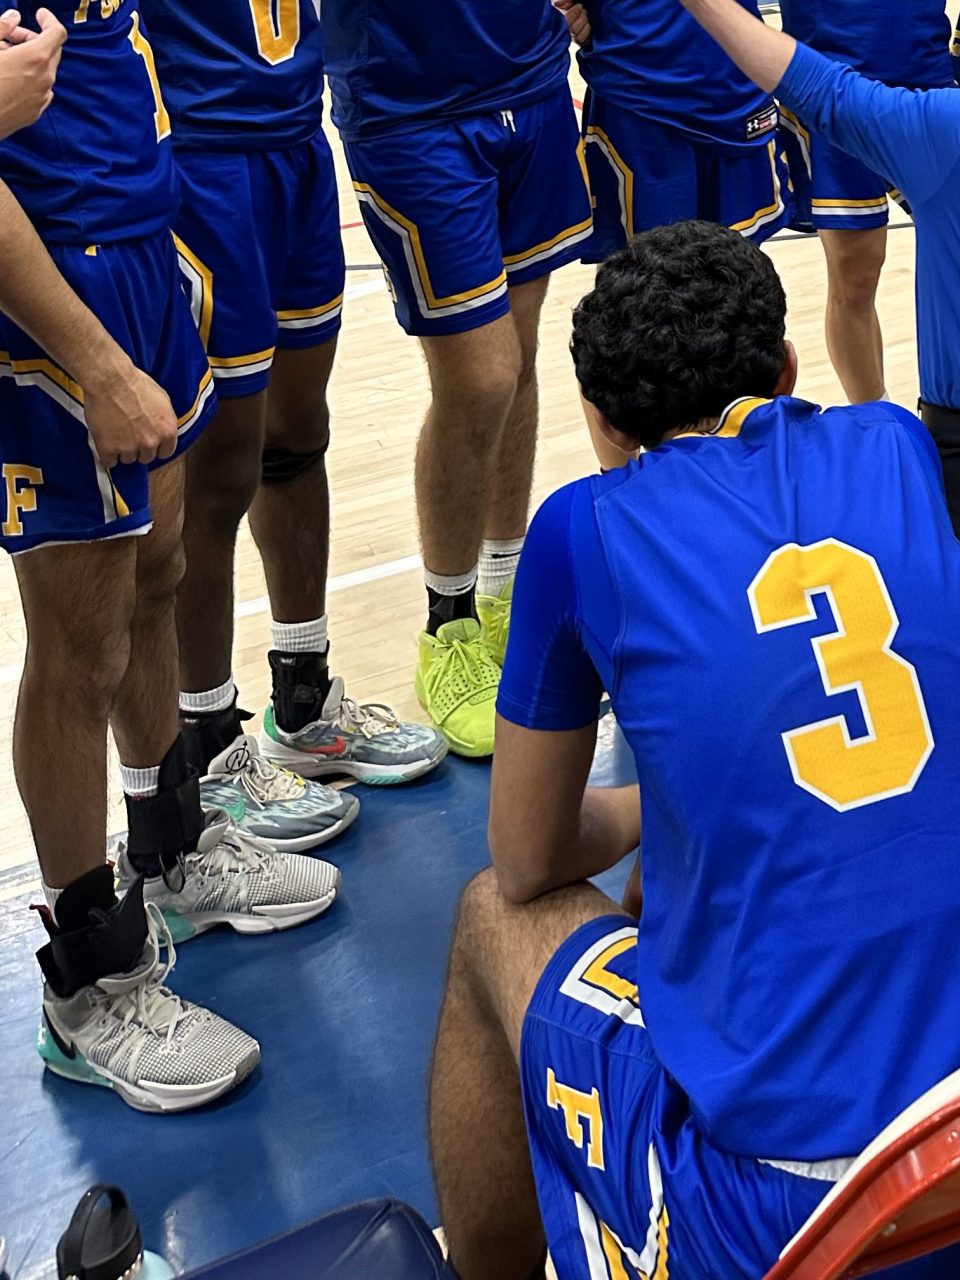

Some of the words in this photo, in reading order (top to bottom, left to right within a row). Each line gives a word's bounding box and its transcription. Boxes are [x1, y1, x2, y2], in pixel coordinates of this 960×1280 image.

[1, 463, 44, 537] F
[746, 537, 935, 813] 3
[546, 1067, 605, 1171] F
